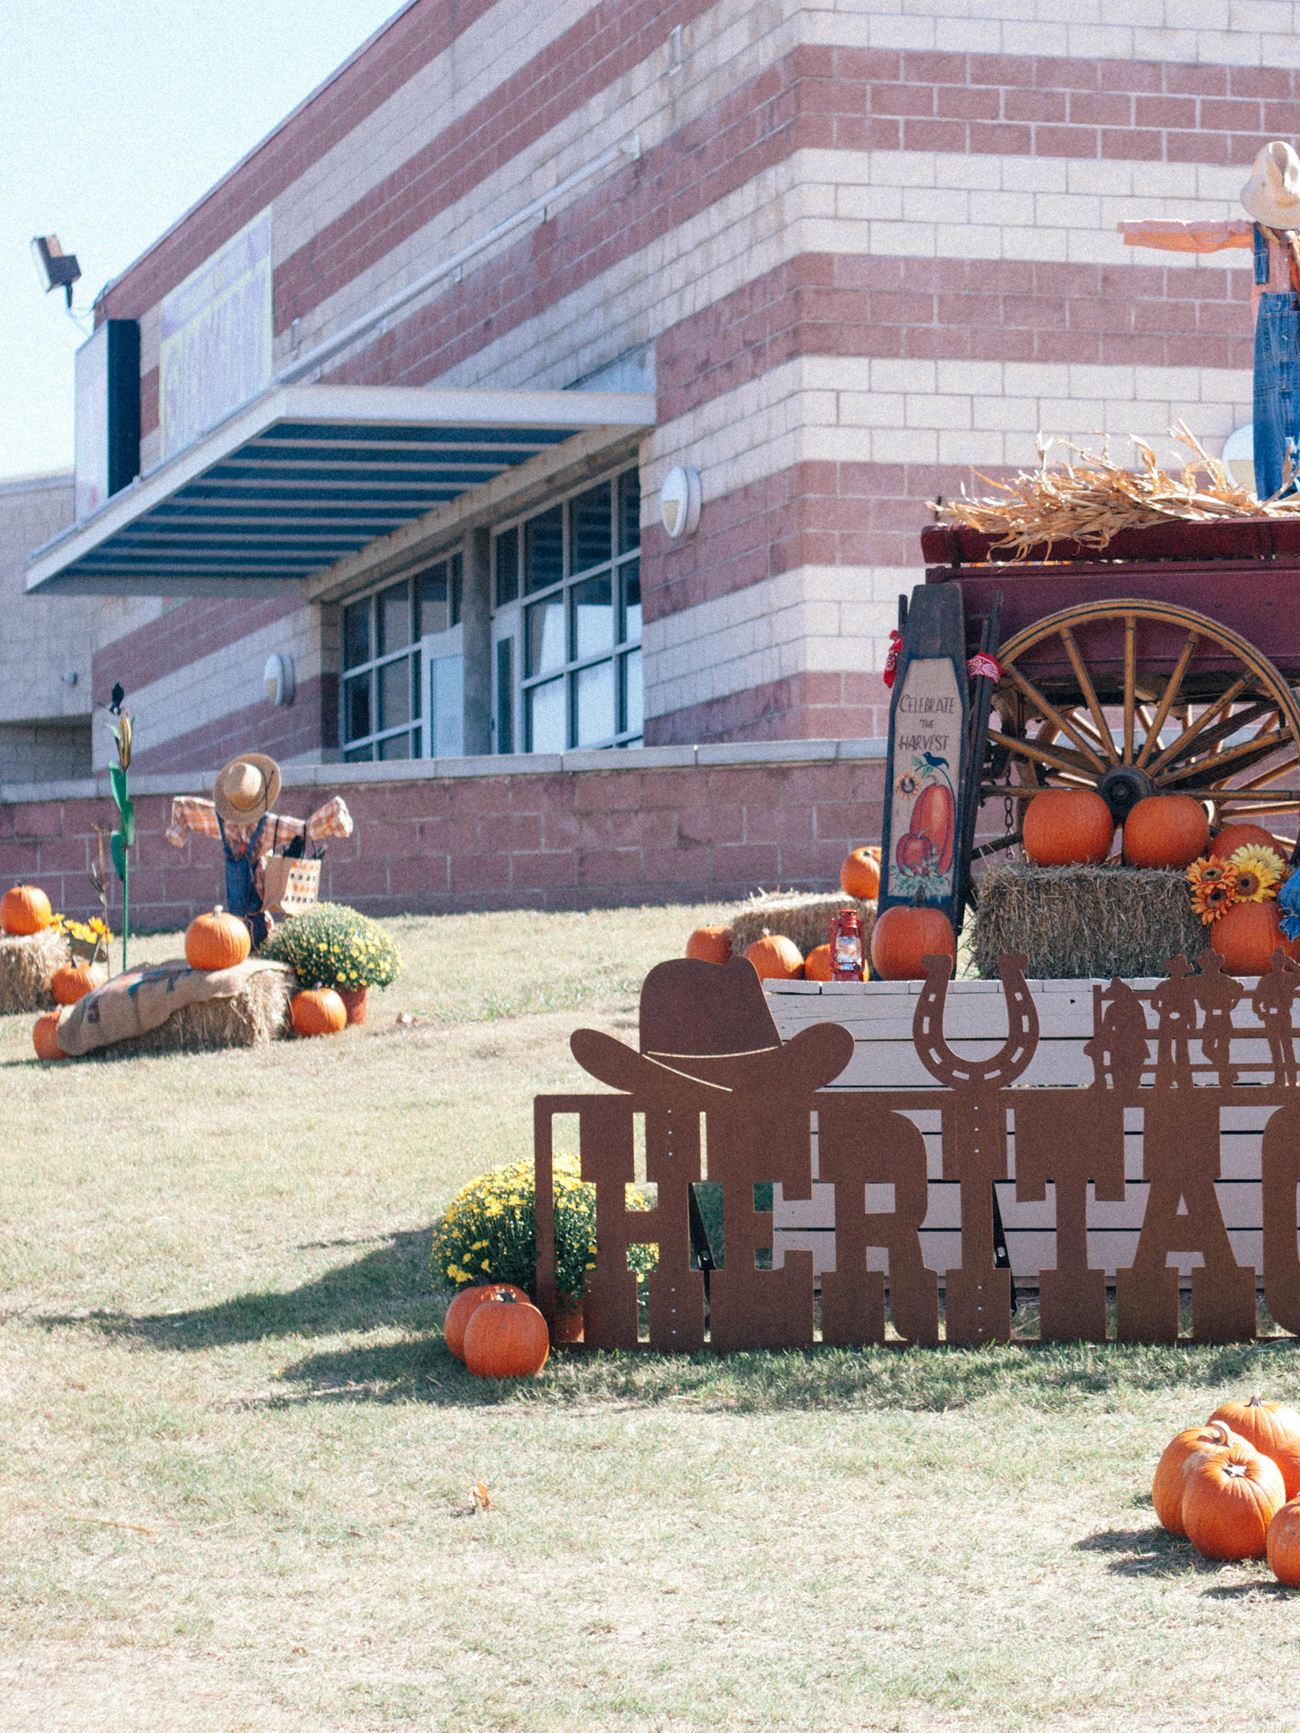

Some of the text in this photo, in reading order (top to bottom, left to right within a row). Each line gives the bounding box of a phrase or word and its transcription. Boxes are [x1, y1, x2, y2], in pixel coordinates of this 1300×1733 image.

[899, 694, 955, 715] CELEBRATE
[919, 718, 934, 729] THE
[899, 735, 950, 751] HARVEST
